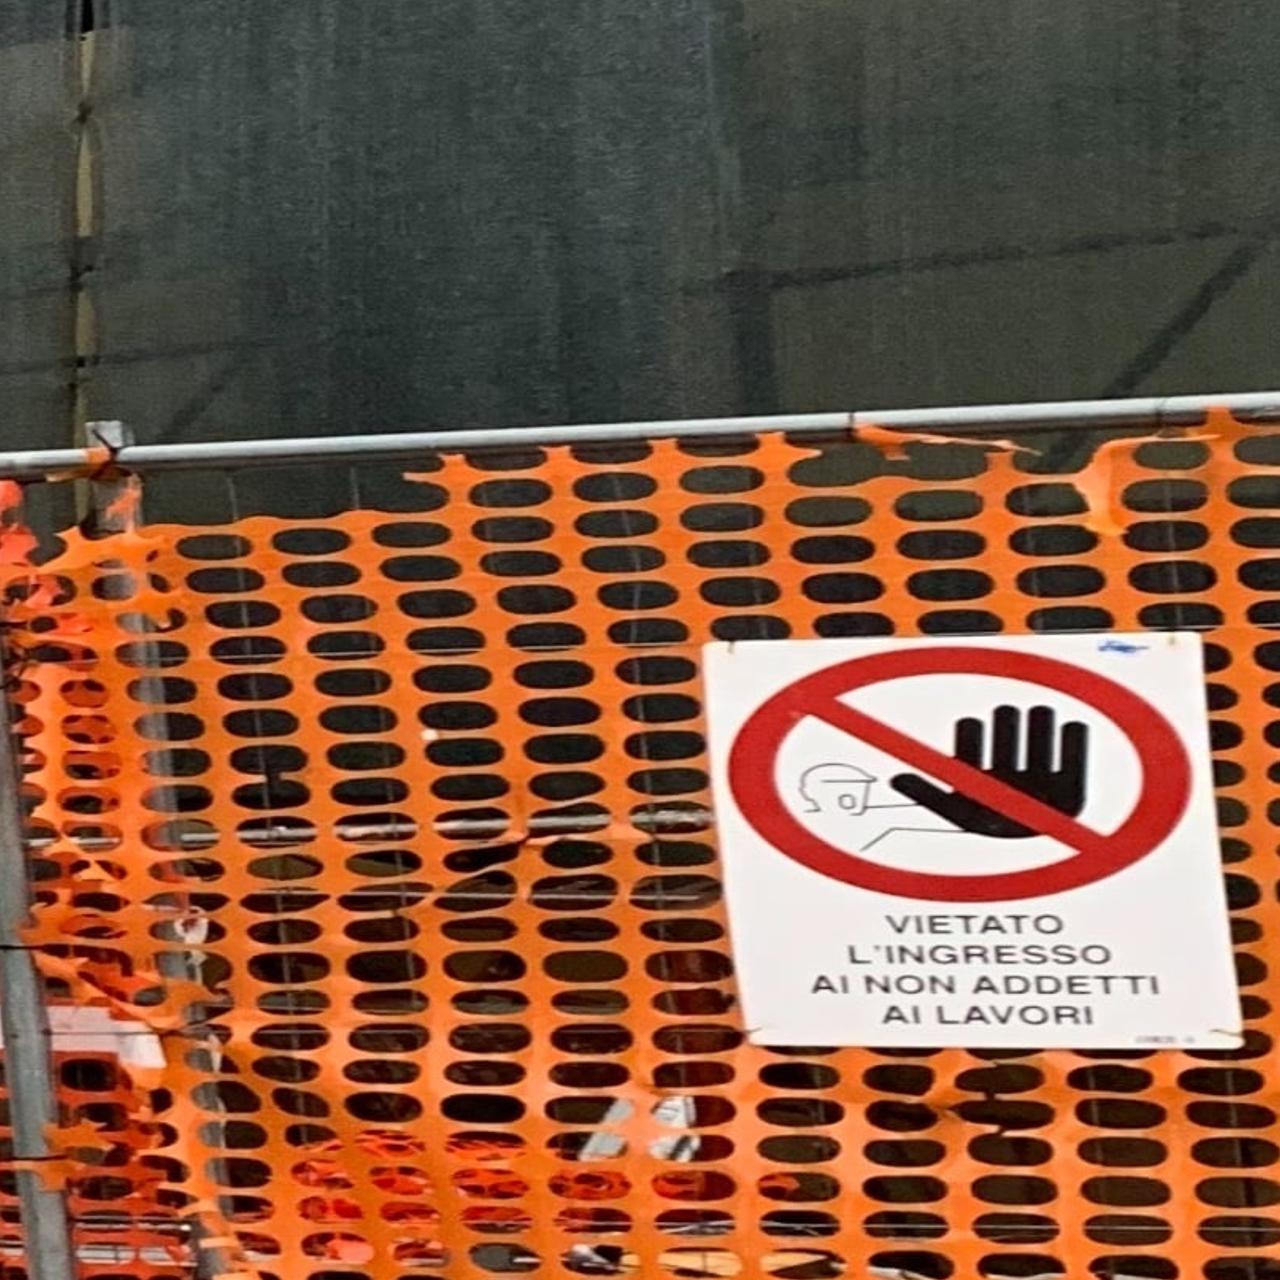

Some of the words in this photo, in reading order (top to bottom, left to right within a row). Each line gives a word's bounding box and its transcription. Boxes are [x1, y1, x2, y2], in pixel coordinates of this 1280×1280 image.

[884, 913, 1064, 936] VIETATO
[847, 943, 1112, 966] L'INGRESSO
[811, 974, 849, 995] AI
[863, 974, 956, 996] NON
[972, 974, 1160, 996] ADDETTI
[881, 1004, 921, 1026] AI
[935, 1004, 1094, 1026] LAVORI
